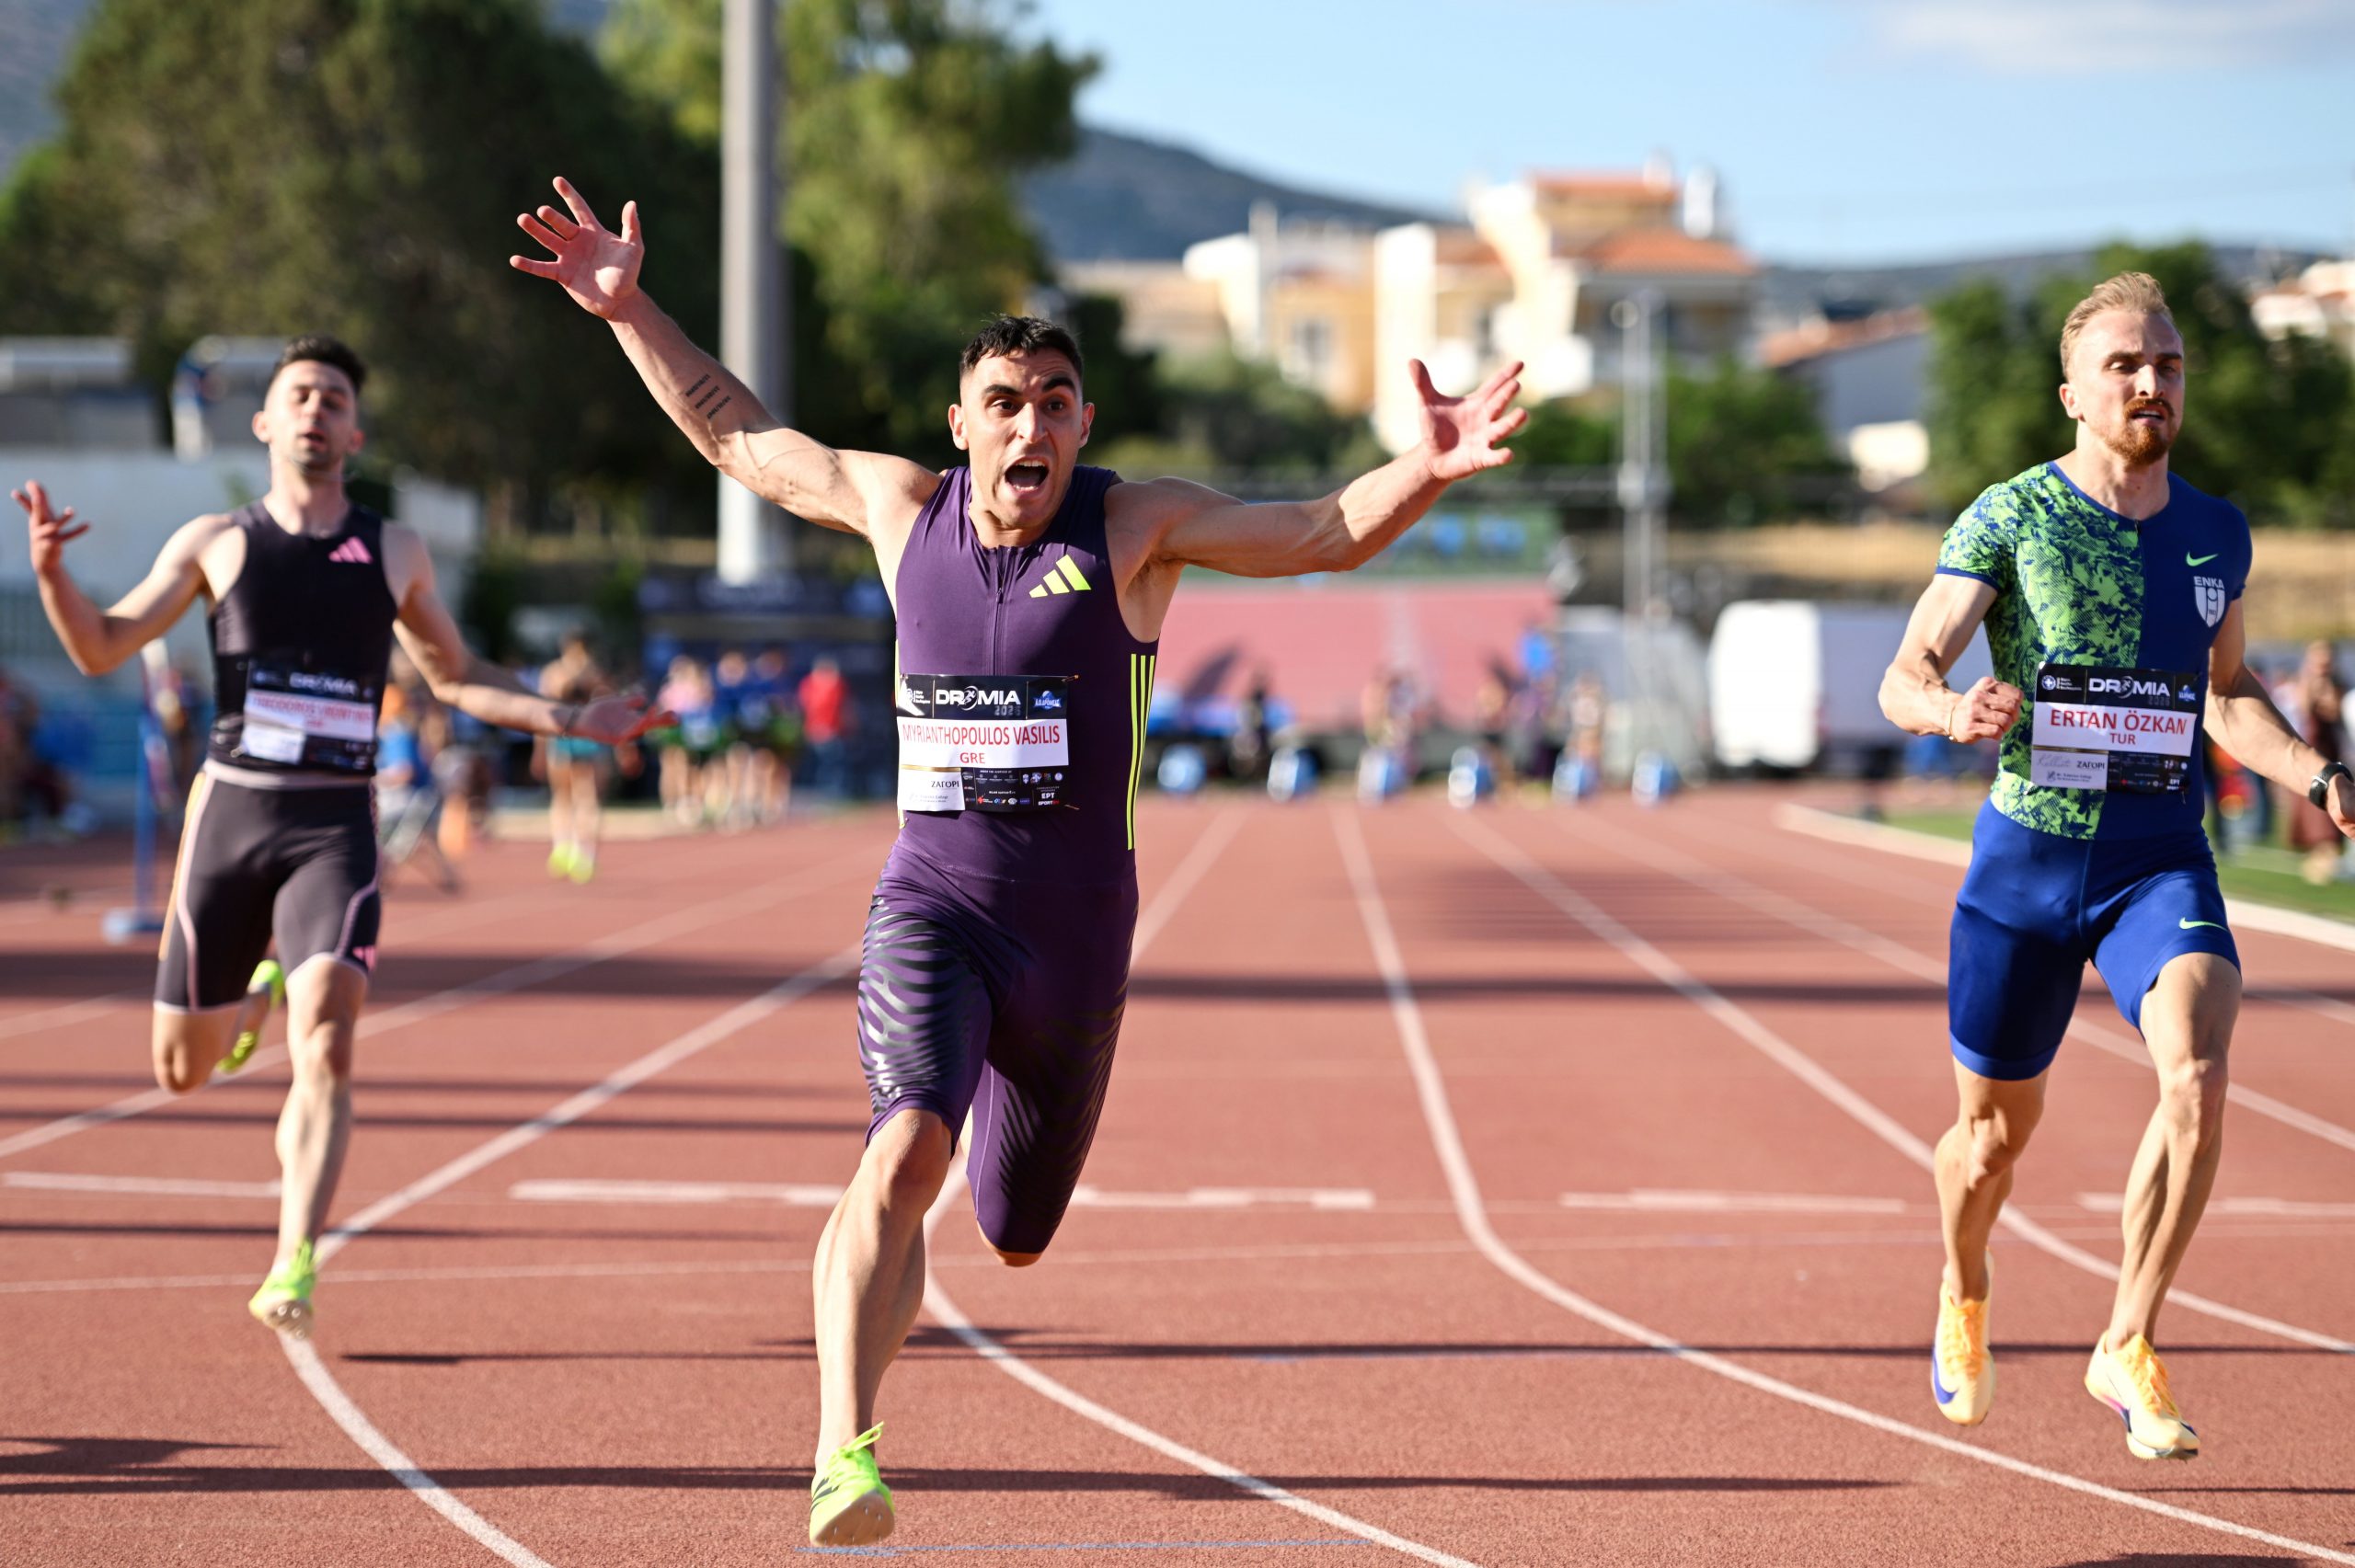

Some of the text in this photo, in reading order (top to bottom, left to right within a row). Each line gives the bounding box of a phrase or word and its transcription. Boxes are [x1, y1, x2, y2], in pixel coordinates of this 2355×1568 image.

[2193, 576, 2225, 589] ENKA
[2089, 677, 2170, 697] DROMIA
[936, 687, 1022, 709] DROMIA
[2050, 709, 2188, 735] ERTAN ÖZKAN
[902, 725, 1061, 745] MYRIANTHOPOULOS VASILIS
[2109, 733, 2136, 745] TUR
[959, 752, 985, 764] GRE
